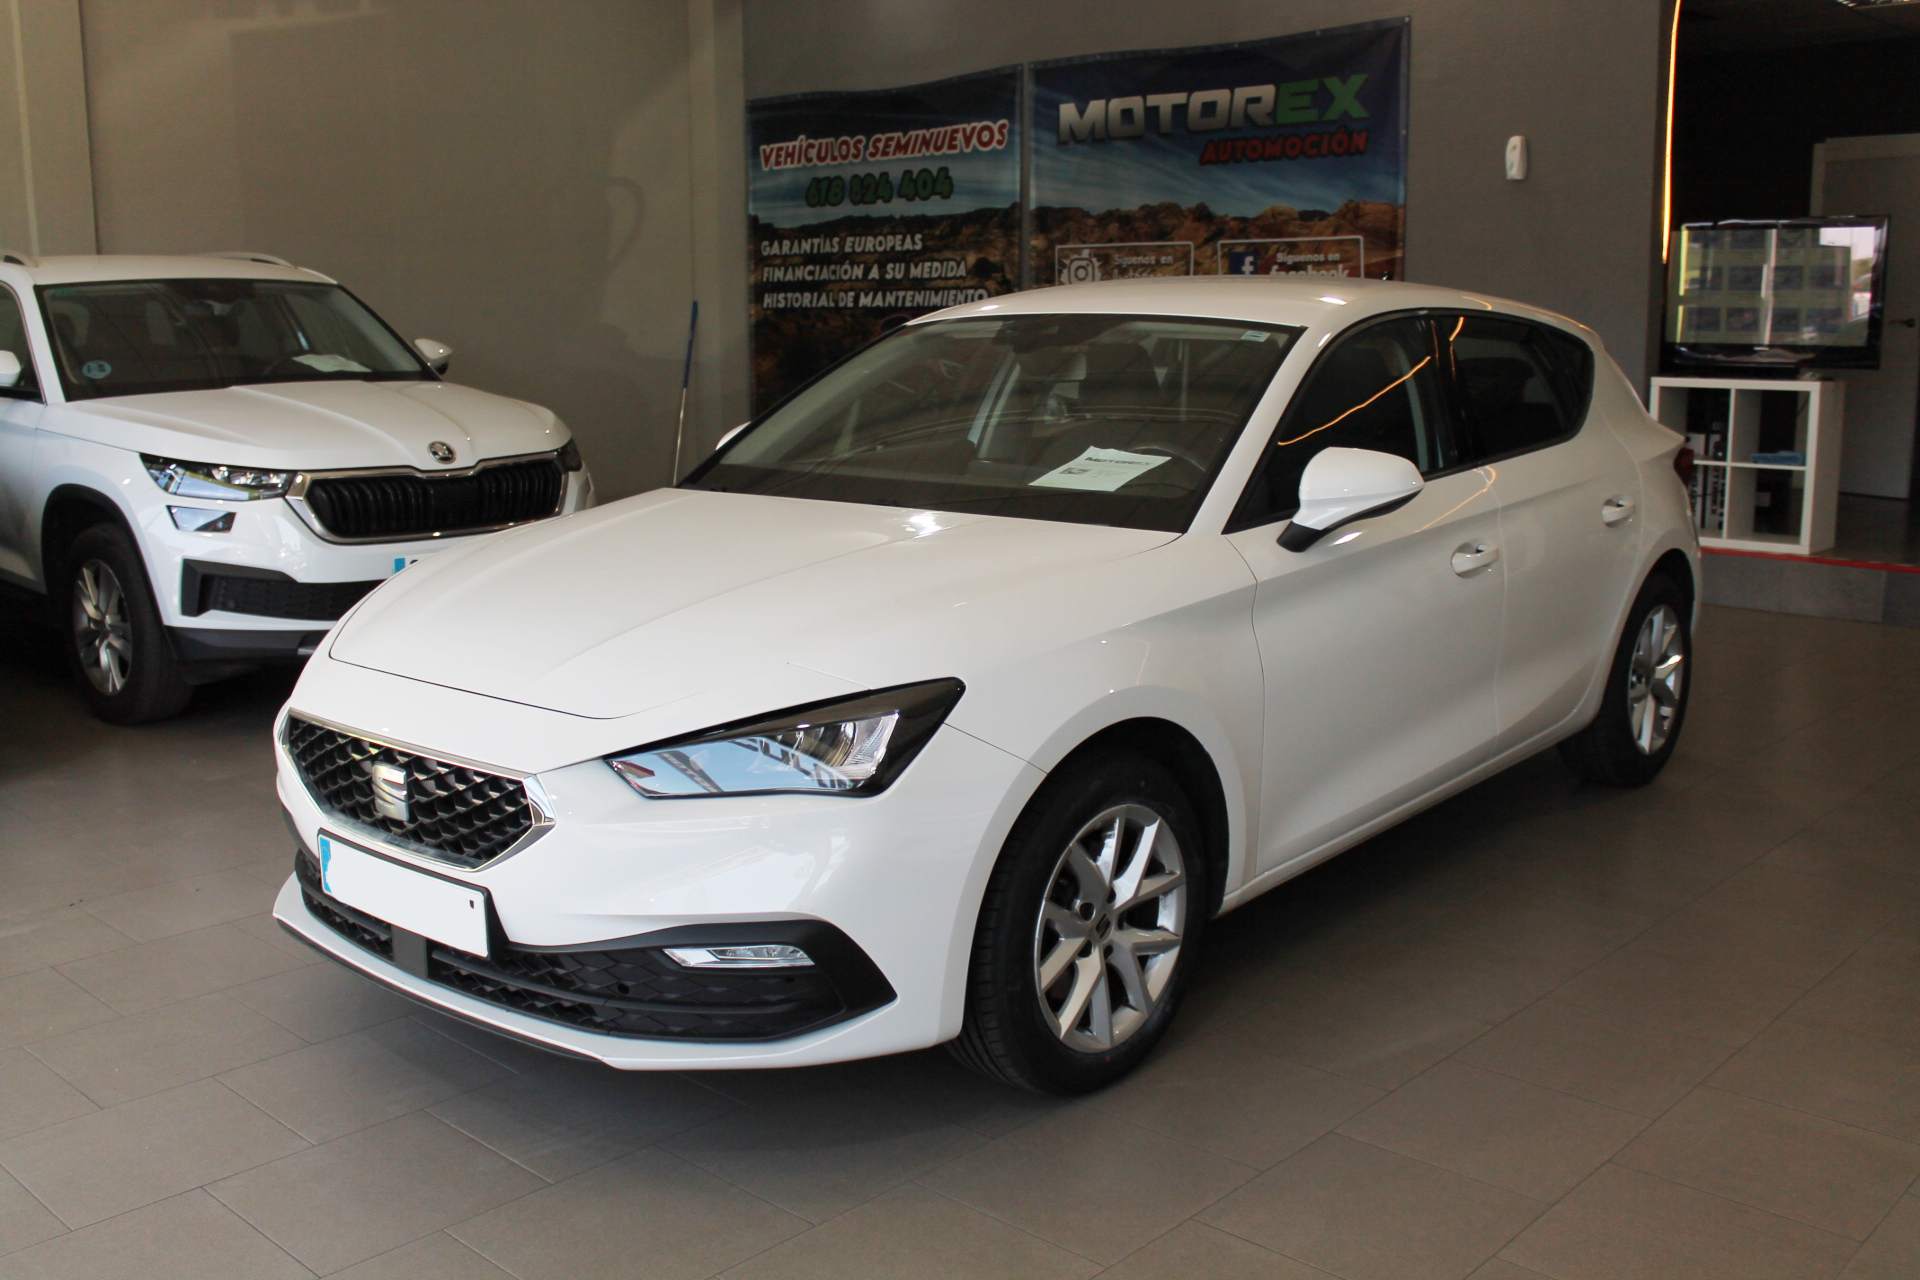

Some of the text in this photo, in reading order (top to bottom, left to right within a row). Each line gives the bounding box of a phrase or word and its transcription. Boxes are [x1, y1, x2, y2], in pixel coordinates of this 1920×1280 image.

[1058, 74, 1369, 144] MOTOREX
[760, 119, 1009, 170] VEHÍCULOS SEMINUEVOS
[1200, 128, 1369, 165] AUTOMOCIÓN
[898, 166, 954, 202] 404
[760, 233, 923, 256] GARANTÍAS EUROPEAS
[763, 260, 967, 282] FINANCIACIÓN A SU MEDIDA
[763, 288, 988, 308] HISTORIAL DE MANTENIMIENTO
